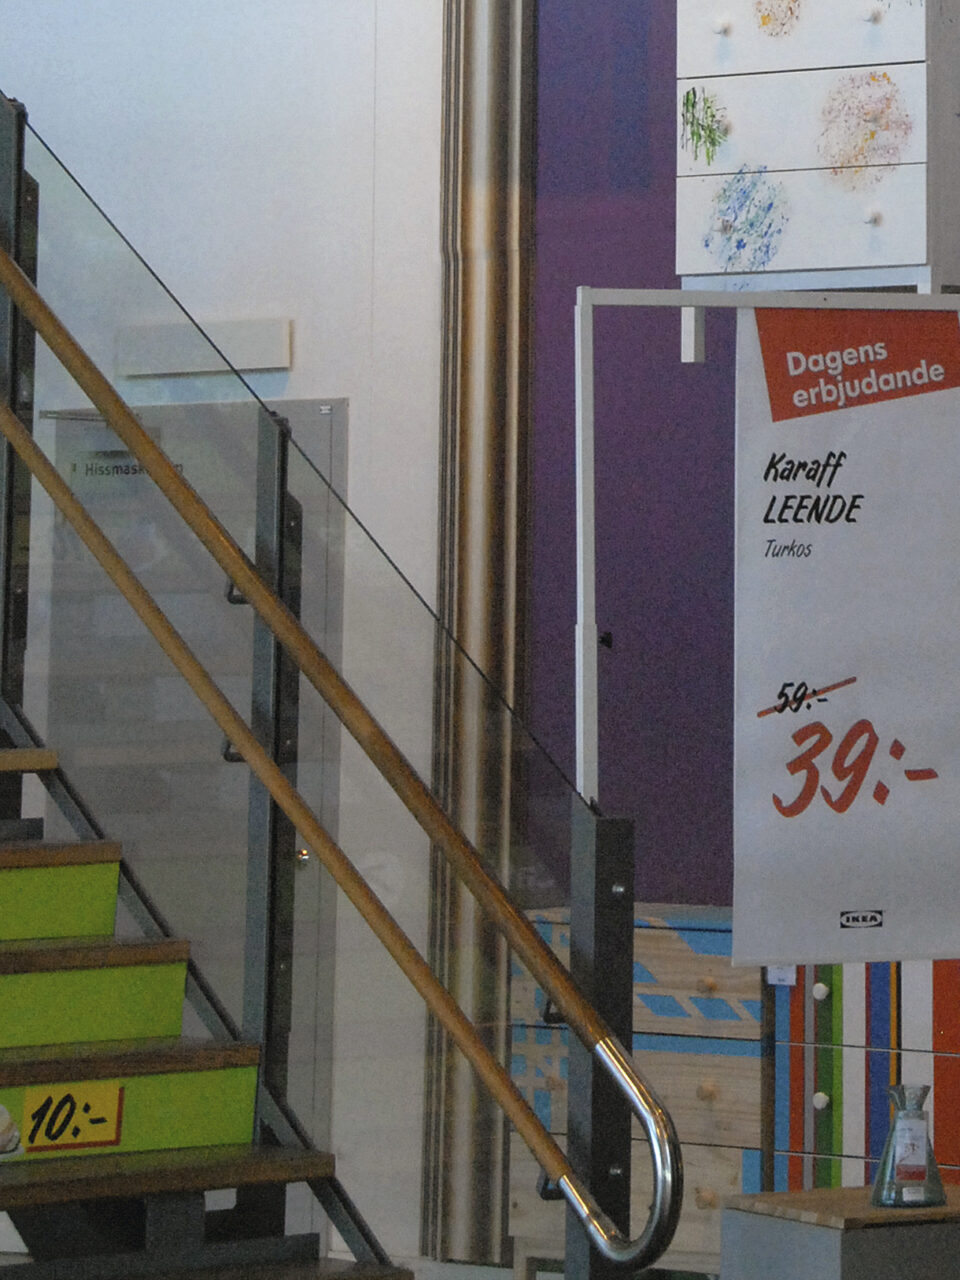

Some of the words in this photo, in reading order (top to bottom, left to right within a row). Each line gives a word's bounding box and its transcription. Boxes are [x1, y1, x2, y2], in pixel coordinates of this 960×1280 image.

[786, 340, 888, 376] Dagens
[792, 360, 945, 408] erbjudande
[763, 451, 847, 488] Karaff
[763, 495, 864, 524] LEENDE
[764, 539, 813, 558] Turkos
[775, 681, 829, 714] 59:-
[771, 719, 939, 818] 39:-
[843, 913, 880, 926] IKEA
[28, 1093, 108, 1145] 10:-
